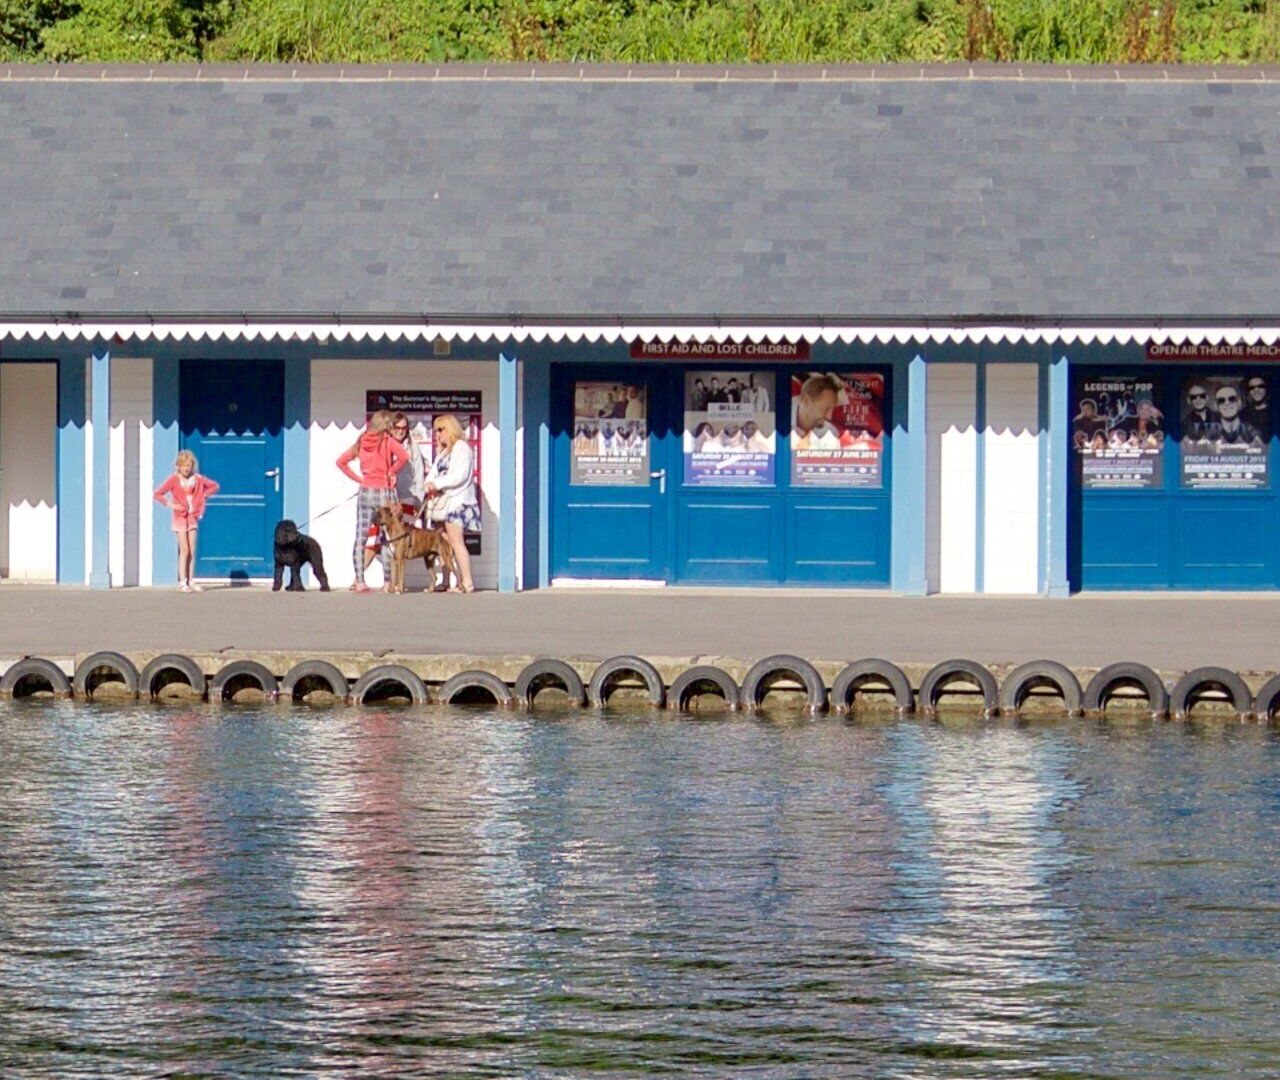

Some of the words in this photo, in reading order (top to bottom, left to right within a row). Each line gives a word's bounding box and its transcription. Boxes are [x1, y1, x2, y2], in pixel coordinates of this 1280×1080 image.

[642, 344, 670, 353] FIRST
[671, 344, 689, 353] AID
[691, 344, 715, 354] AND
[717, 344, 743, 354] LOST
[745, 344, 797, 355] CHILDREN
[1150, 345, 1179, 355] OPEN
[1181, 345, 1198, 355] AIR
[1200, 345, 1243, 355] THEATRE
[1084, 383, 1126, 391] LEGENDS
[1135, 383, 1153, 391] POP
[796, 450, 833, 458] SATURDAY
[833, 450, 842, 458] 27
[842, 450, 860, 458] JUNE
[1184, 455, 1208, 463] FRIDAY
[1210, 455, 1218, 463] 14
[1219, 455, 1248, 463] AUGUST
